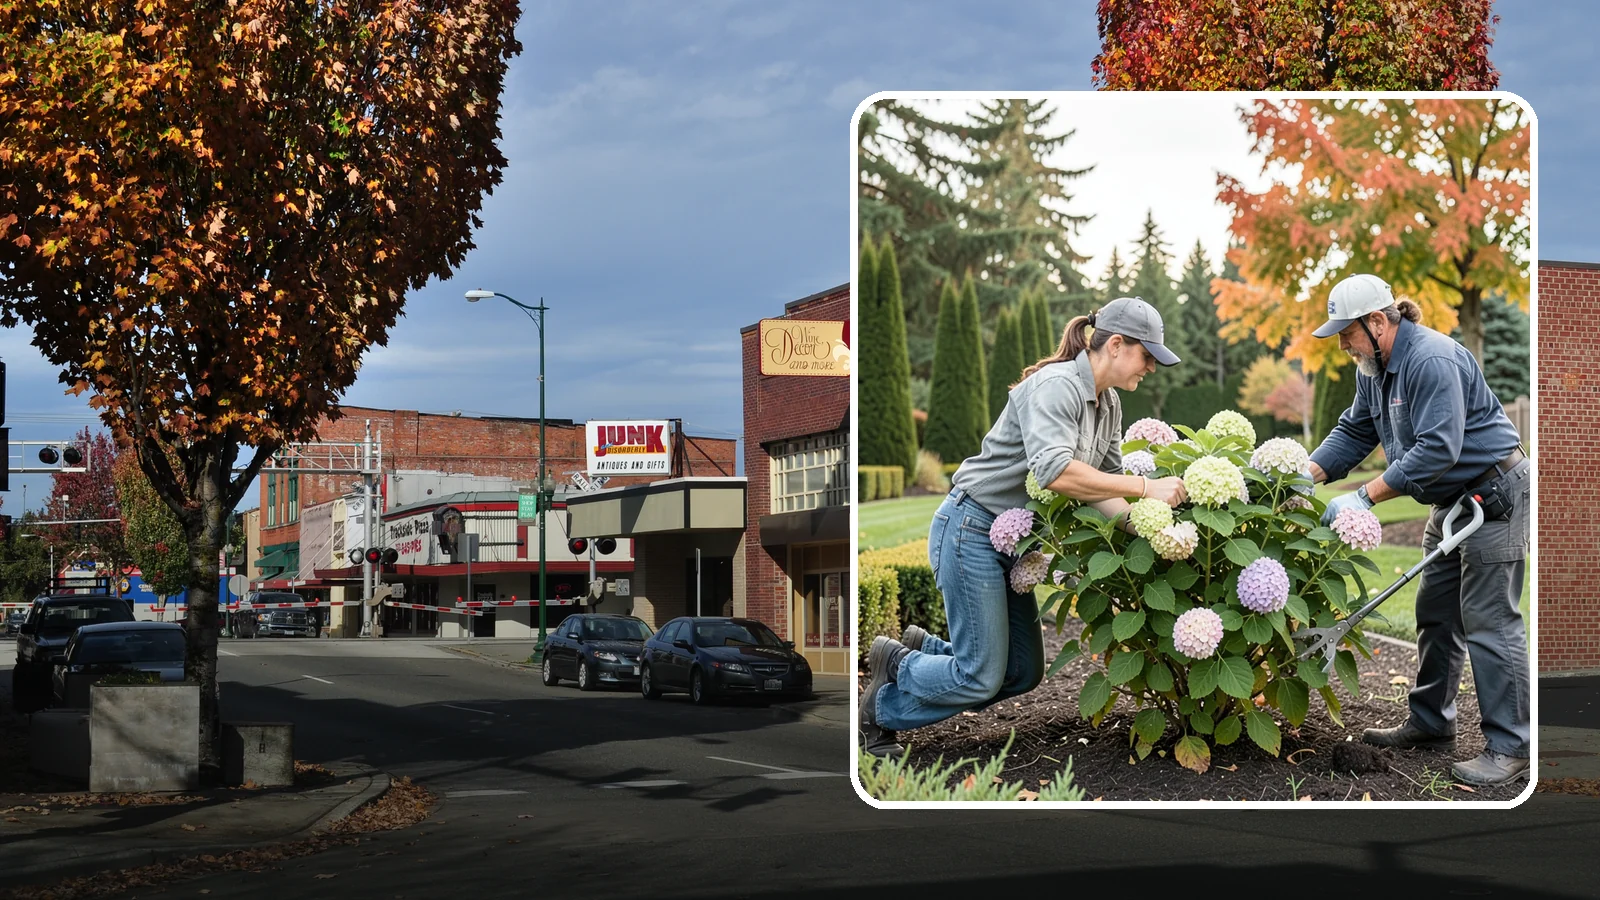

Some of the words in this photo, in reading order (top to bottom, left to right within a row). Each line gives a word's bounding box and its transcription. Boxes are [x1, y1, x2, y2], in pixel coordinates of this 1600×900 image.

[596, 425, 664, 457] JUNK
[607, 446, 646, 454] DISORDERLY
[596, 461, 628, 470] ANTIQUES
[631, 461, 644, 470] AND
[647, 460, 665, 470] GIFTS
[573, 473, 589, 492] RAIL
[590, 476, 608, 492] SING
[352, 498, 365, 511] CRO
[414, 520, 429, 536] Pizza
